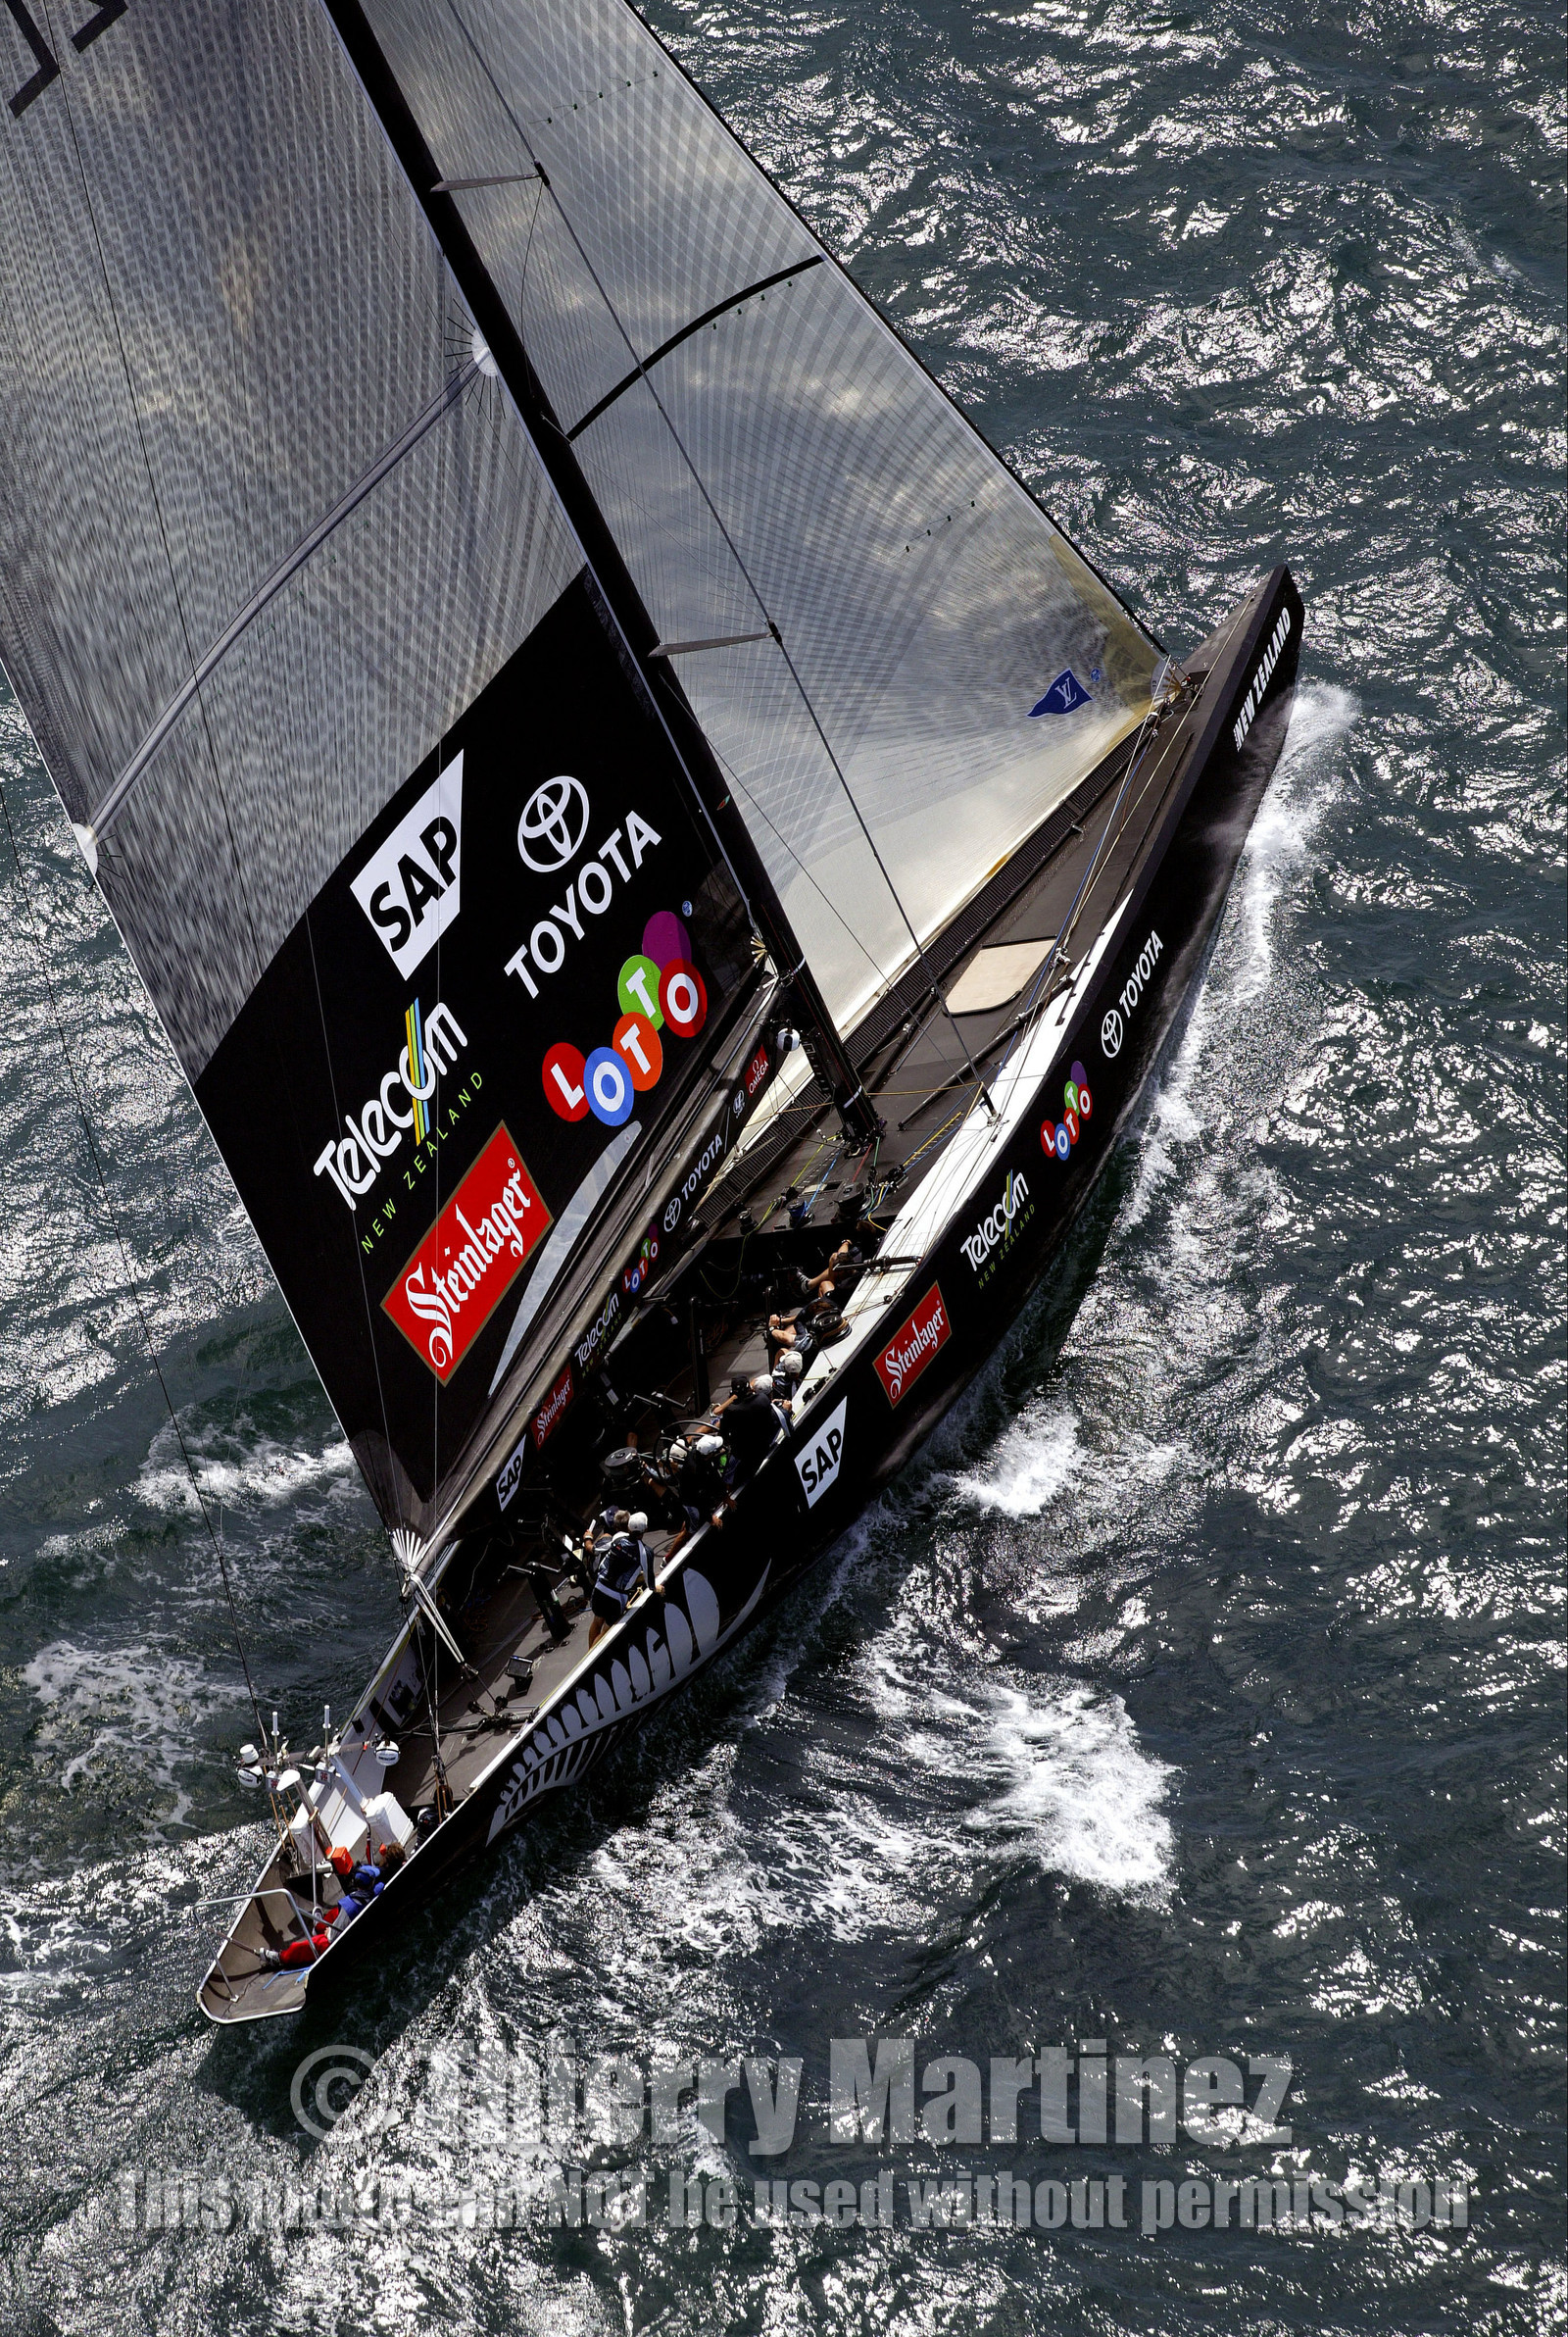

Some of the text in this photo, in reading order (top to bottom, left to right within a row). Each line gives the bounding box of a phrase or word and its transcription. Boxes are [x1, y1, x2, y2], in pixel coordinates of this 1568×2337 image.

[1233, 607, 1291, 753] NEW ZEALAND
[369, 816, 458, 952] SAP
[504, 810, 662, 999] TOYOTA
[1119, 930, 1164, 1019] TOYOTA
[551, 967, 699, 1112] LOTTO
[749, 1060, 768, 1094] OMEGA
[361, 1072, 483, 1254] NEW ZEALAND
[1043, 1086, 1092, 1153] LOTTO
[681, 1133, 723, 1201] TOYOTA
[406, 1167, 530, 1368] Steinlager
[623, 1241, 659, 1291] LOTTO
[979, 1204, 1035, 1290] NEW ZEALAND
[886, 1305, 945, 1399] Steinlager
[537, 1377, 571, 1446] Steinlager
[498, 1454, 522, 1504] SAP
[801, 1427, 842, 1495] SAP
